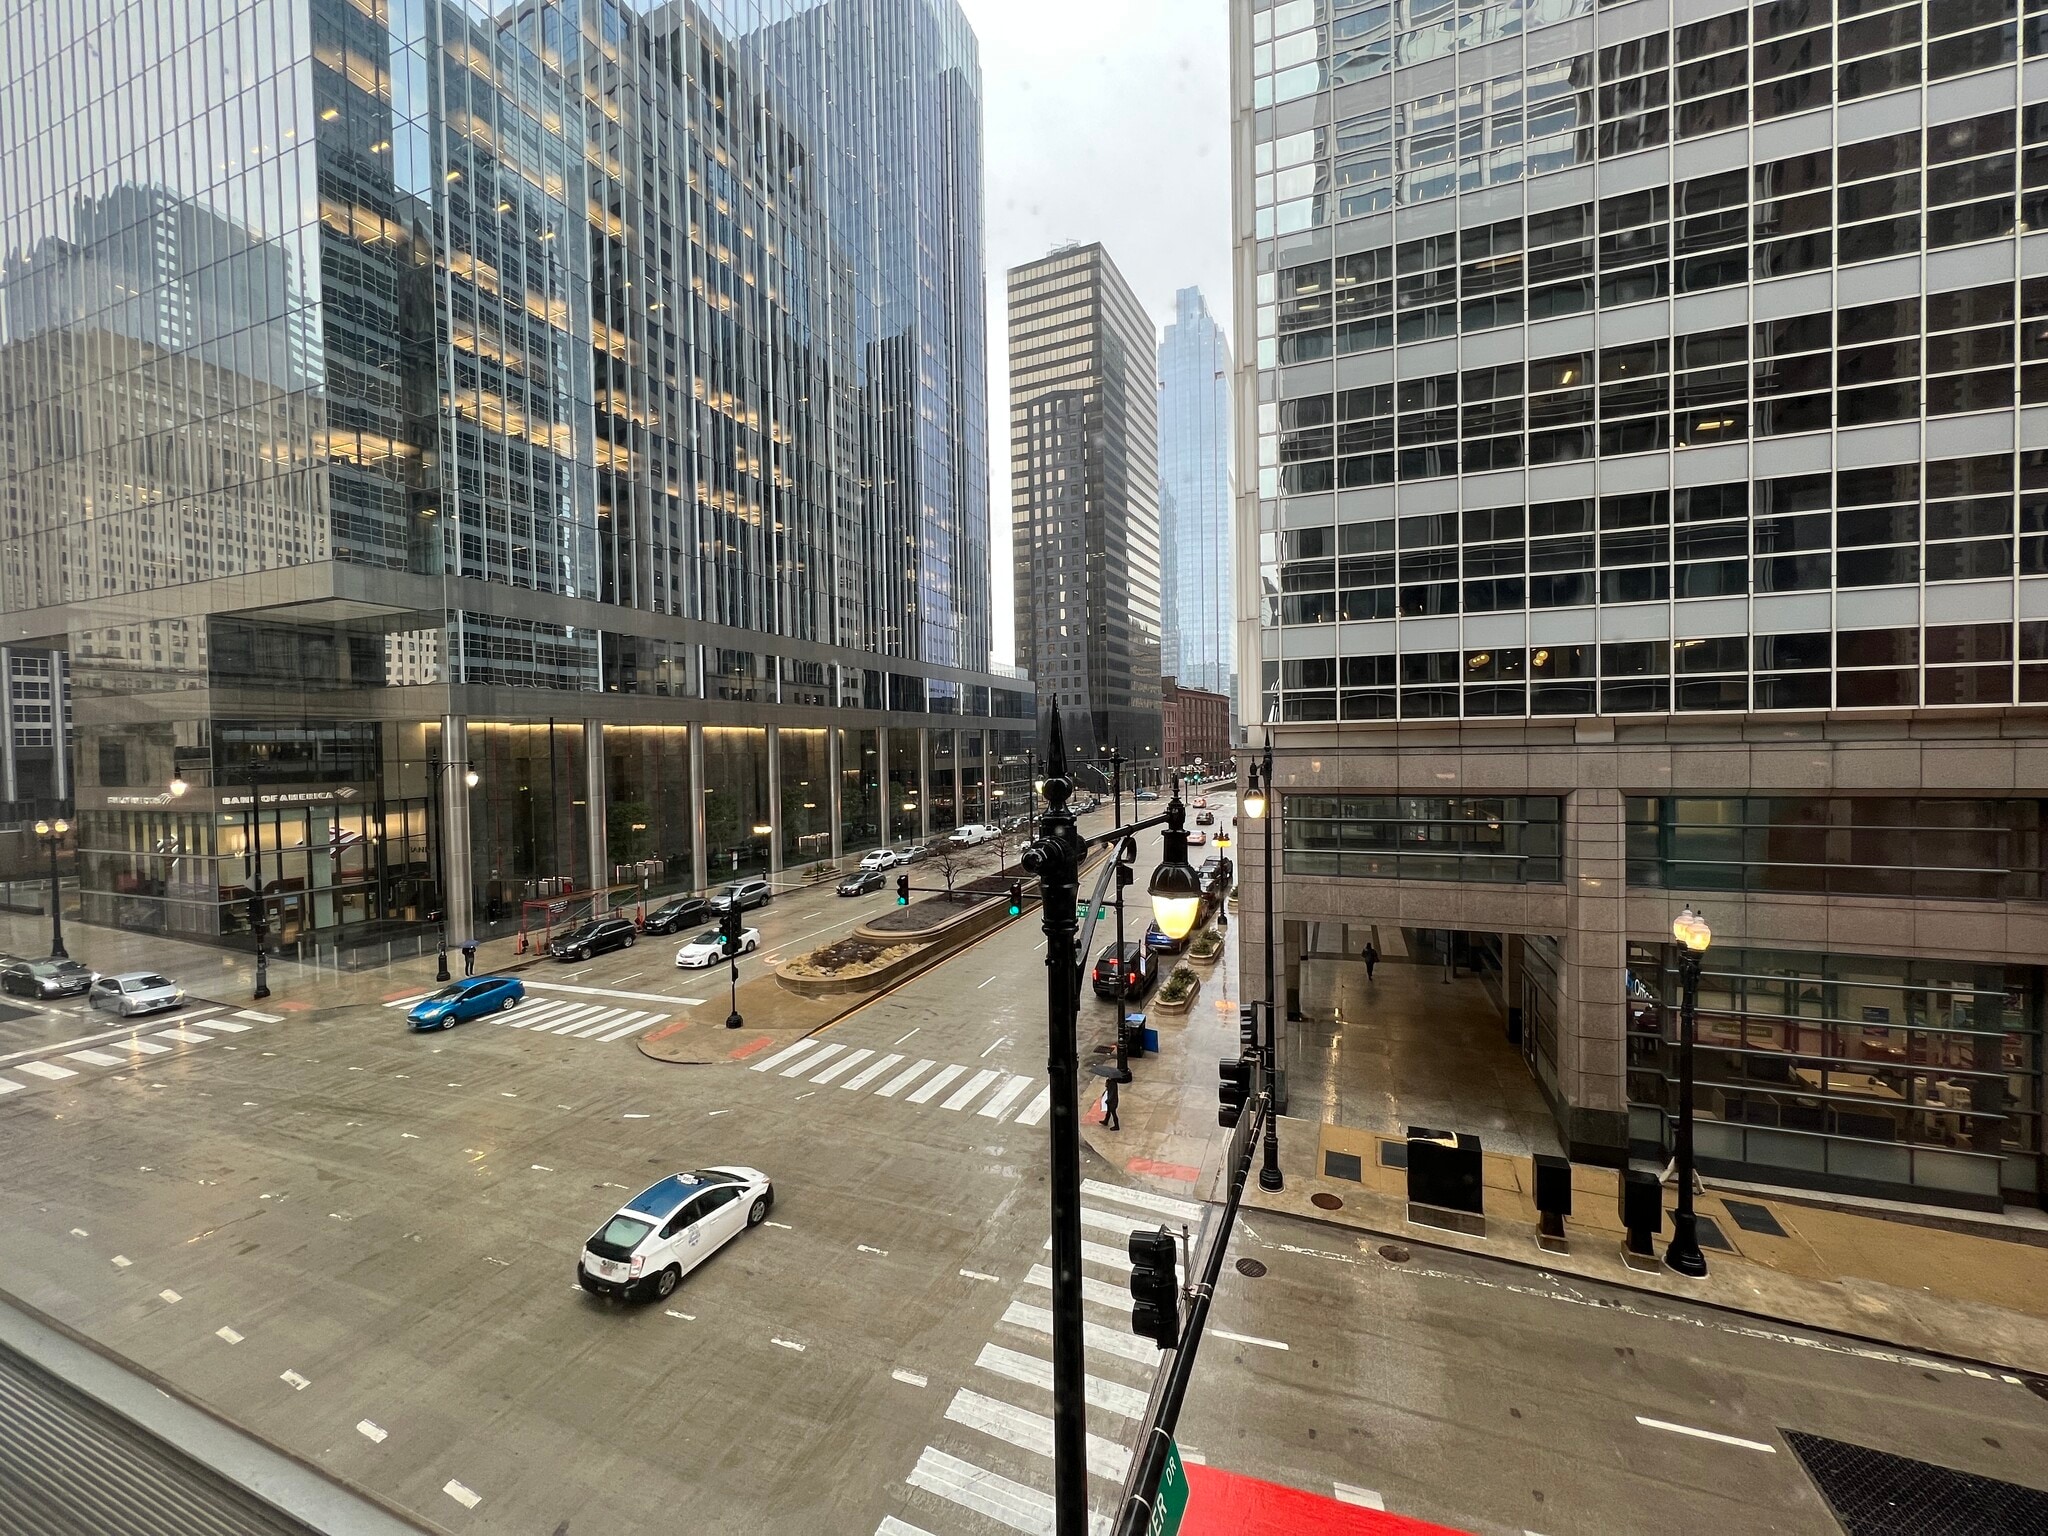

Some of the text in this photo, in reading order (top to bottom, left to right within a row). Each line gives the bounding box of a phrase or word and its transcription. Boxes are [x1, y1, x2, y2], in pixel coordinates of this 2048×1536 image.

[261, 795, 278, 803] OF
[280, 792, 334, 801] AMERICA
[1166, 1456, 1177, 1487] DR
